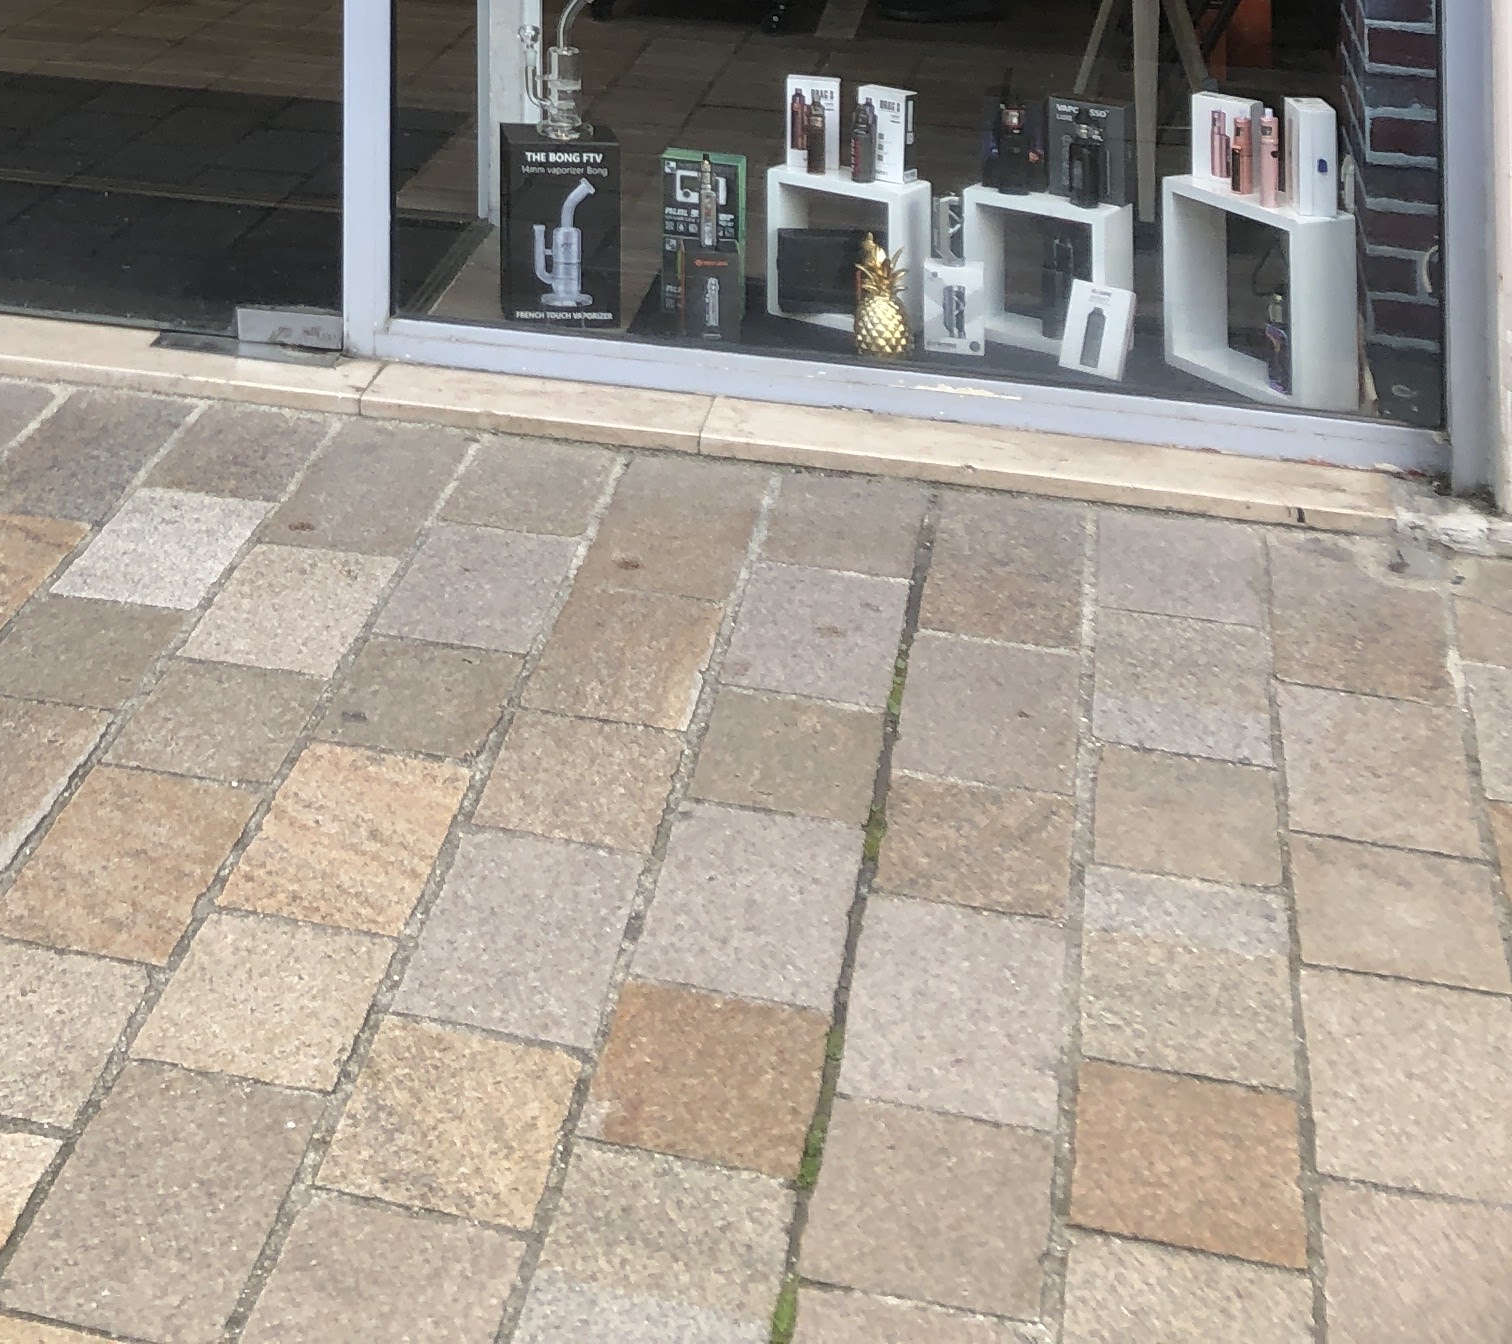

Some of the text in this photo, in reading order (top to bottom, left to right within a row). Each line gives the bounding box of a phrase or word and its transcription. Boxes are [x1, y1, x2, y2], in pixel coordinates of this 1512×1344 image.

[525, 152, 603, 164] THE BONG FTV
